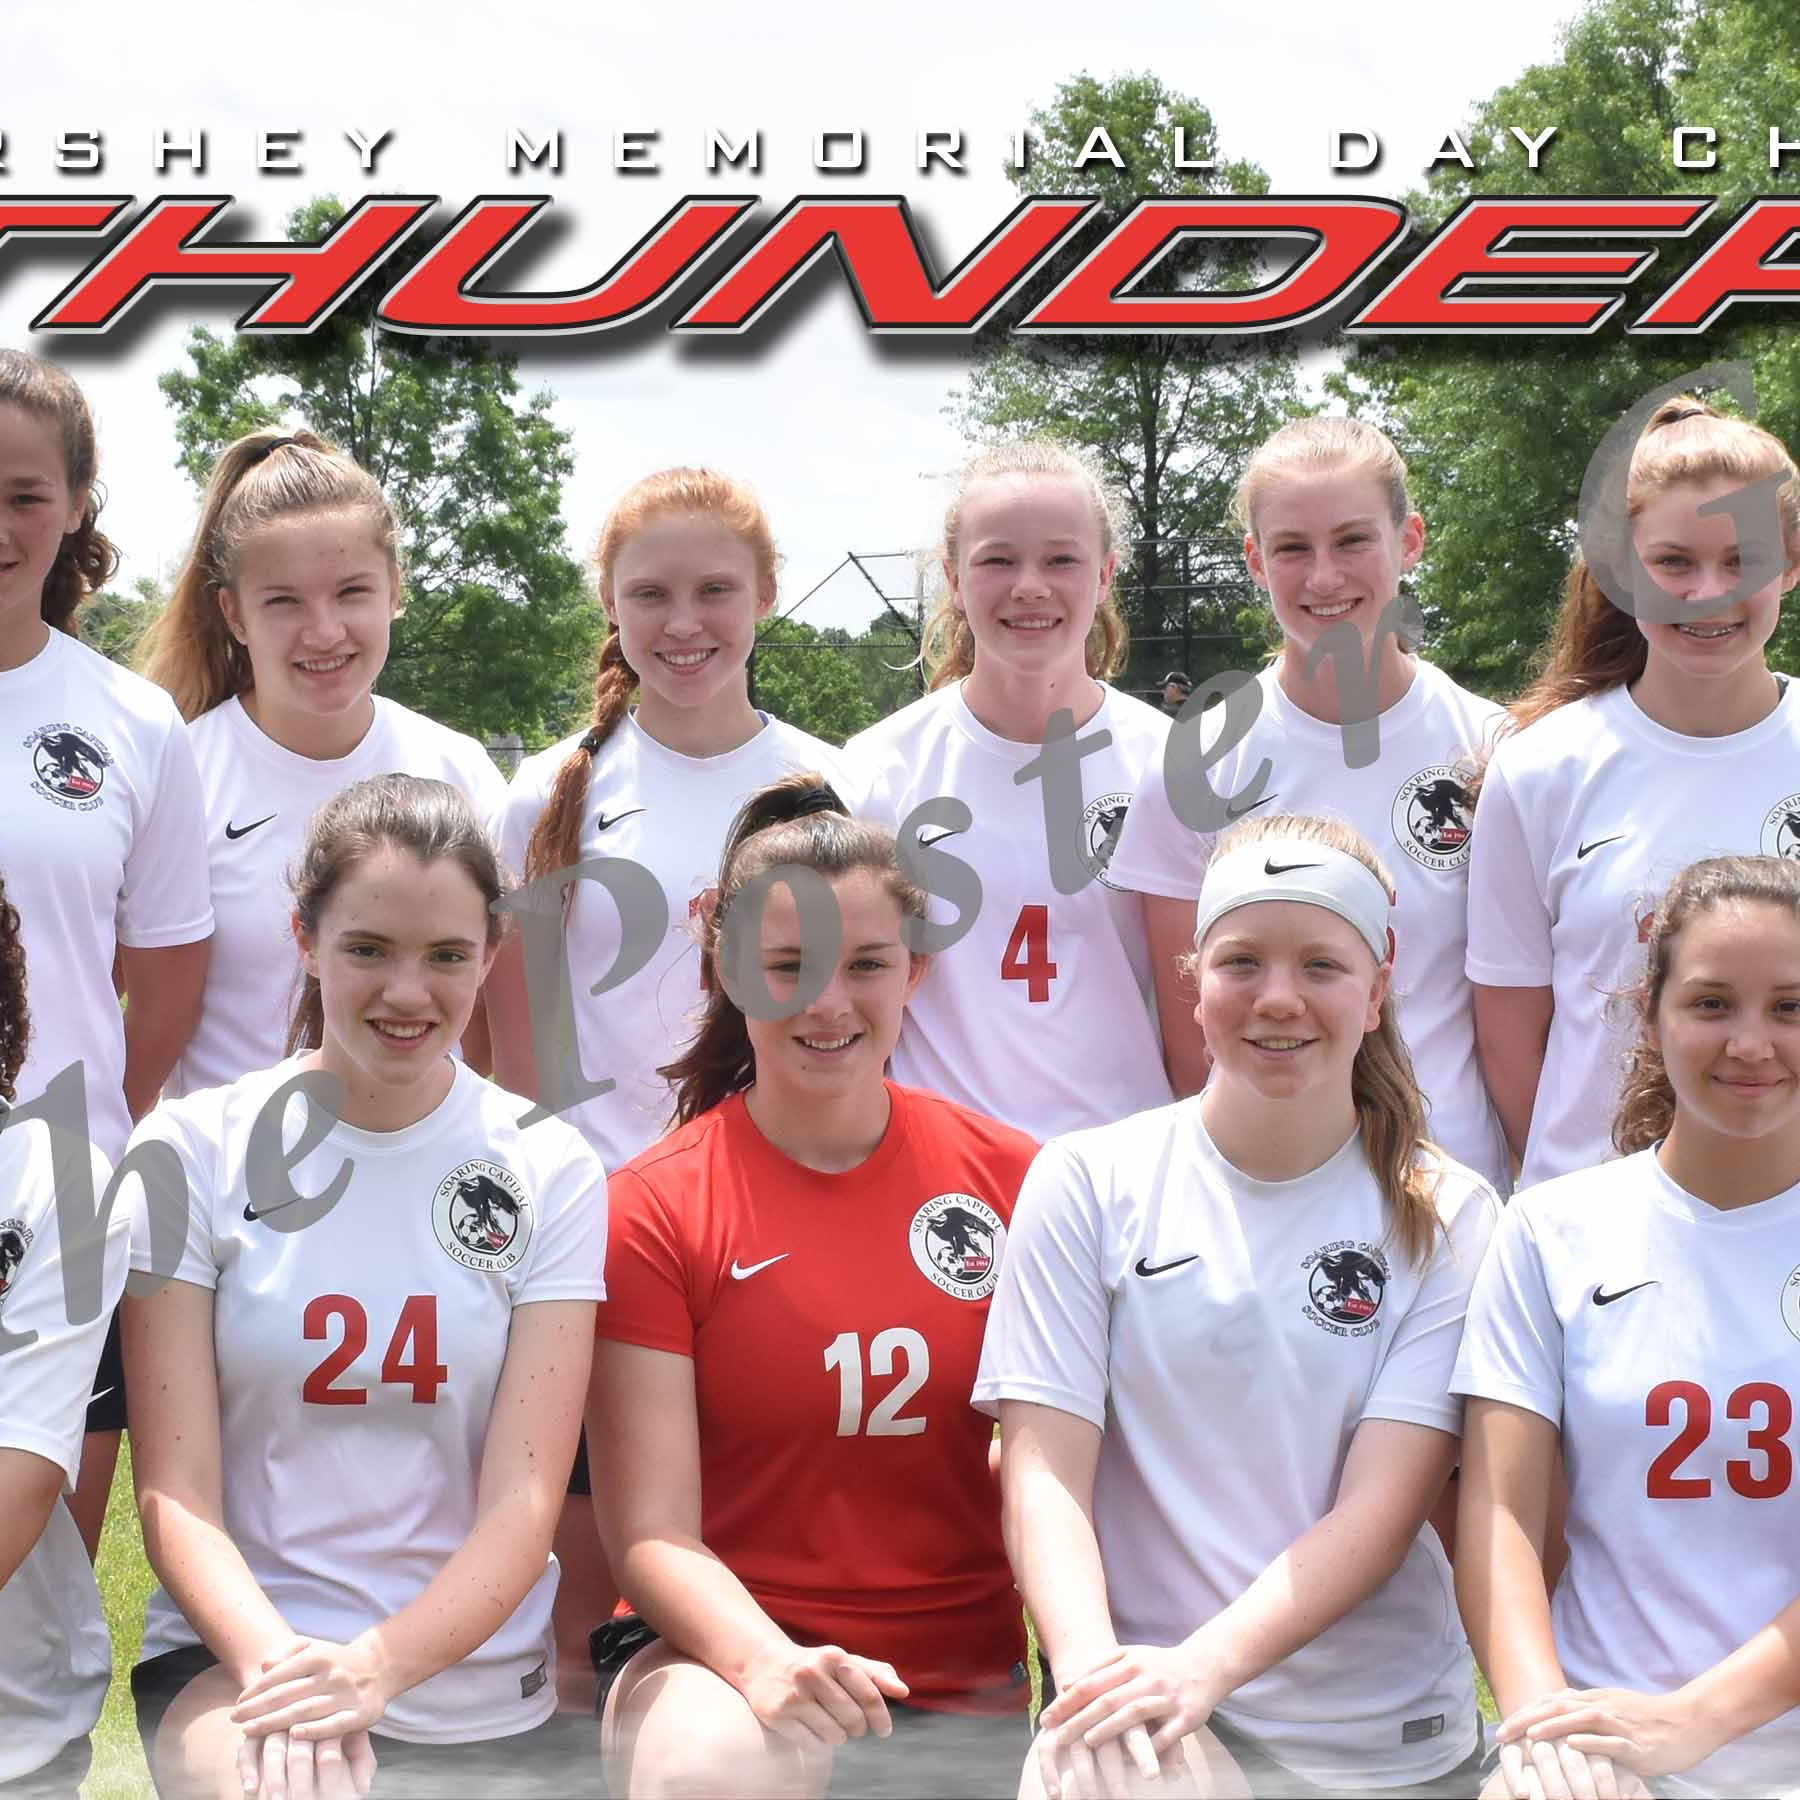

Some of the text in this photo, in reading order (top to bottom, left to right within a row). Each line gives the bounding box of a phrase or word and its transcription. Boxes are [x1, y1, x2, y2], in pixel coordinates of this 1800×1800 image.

[1400, 768, 1446, 801] SOARING
[1403, 840, 1472, 868] SOCCER CLU
[1000, 904, 1057, 1003] 4
[440, 1162, 529, 1211] SOARING CAPITAL
[913, 1195, 1002, 1234] SOARING CAPITAL
[446, 1241, 494, 1270] SOCCER
[931, 1271, 975, 1298] SOCCER
[301, 1293, 448, 1406] 24
[823, 1326, 931, 1438] 12
[1644, 1380, 1794, 1500] 23
